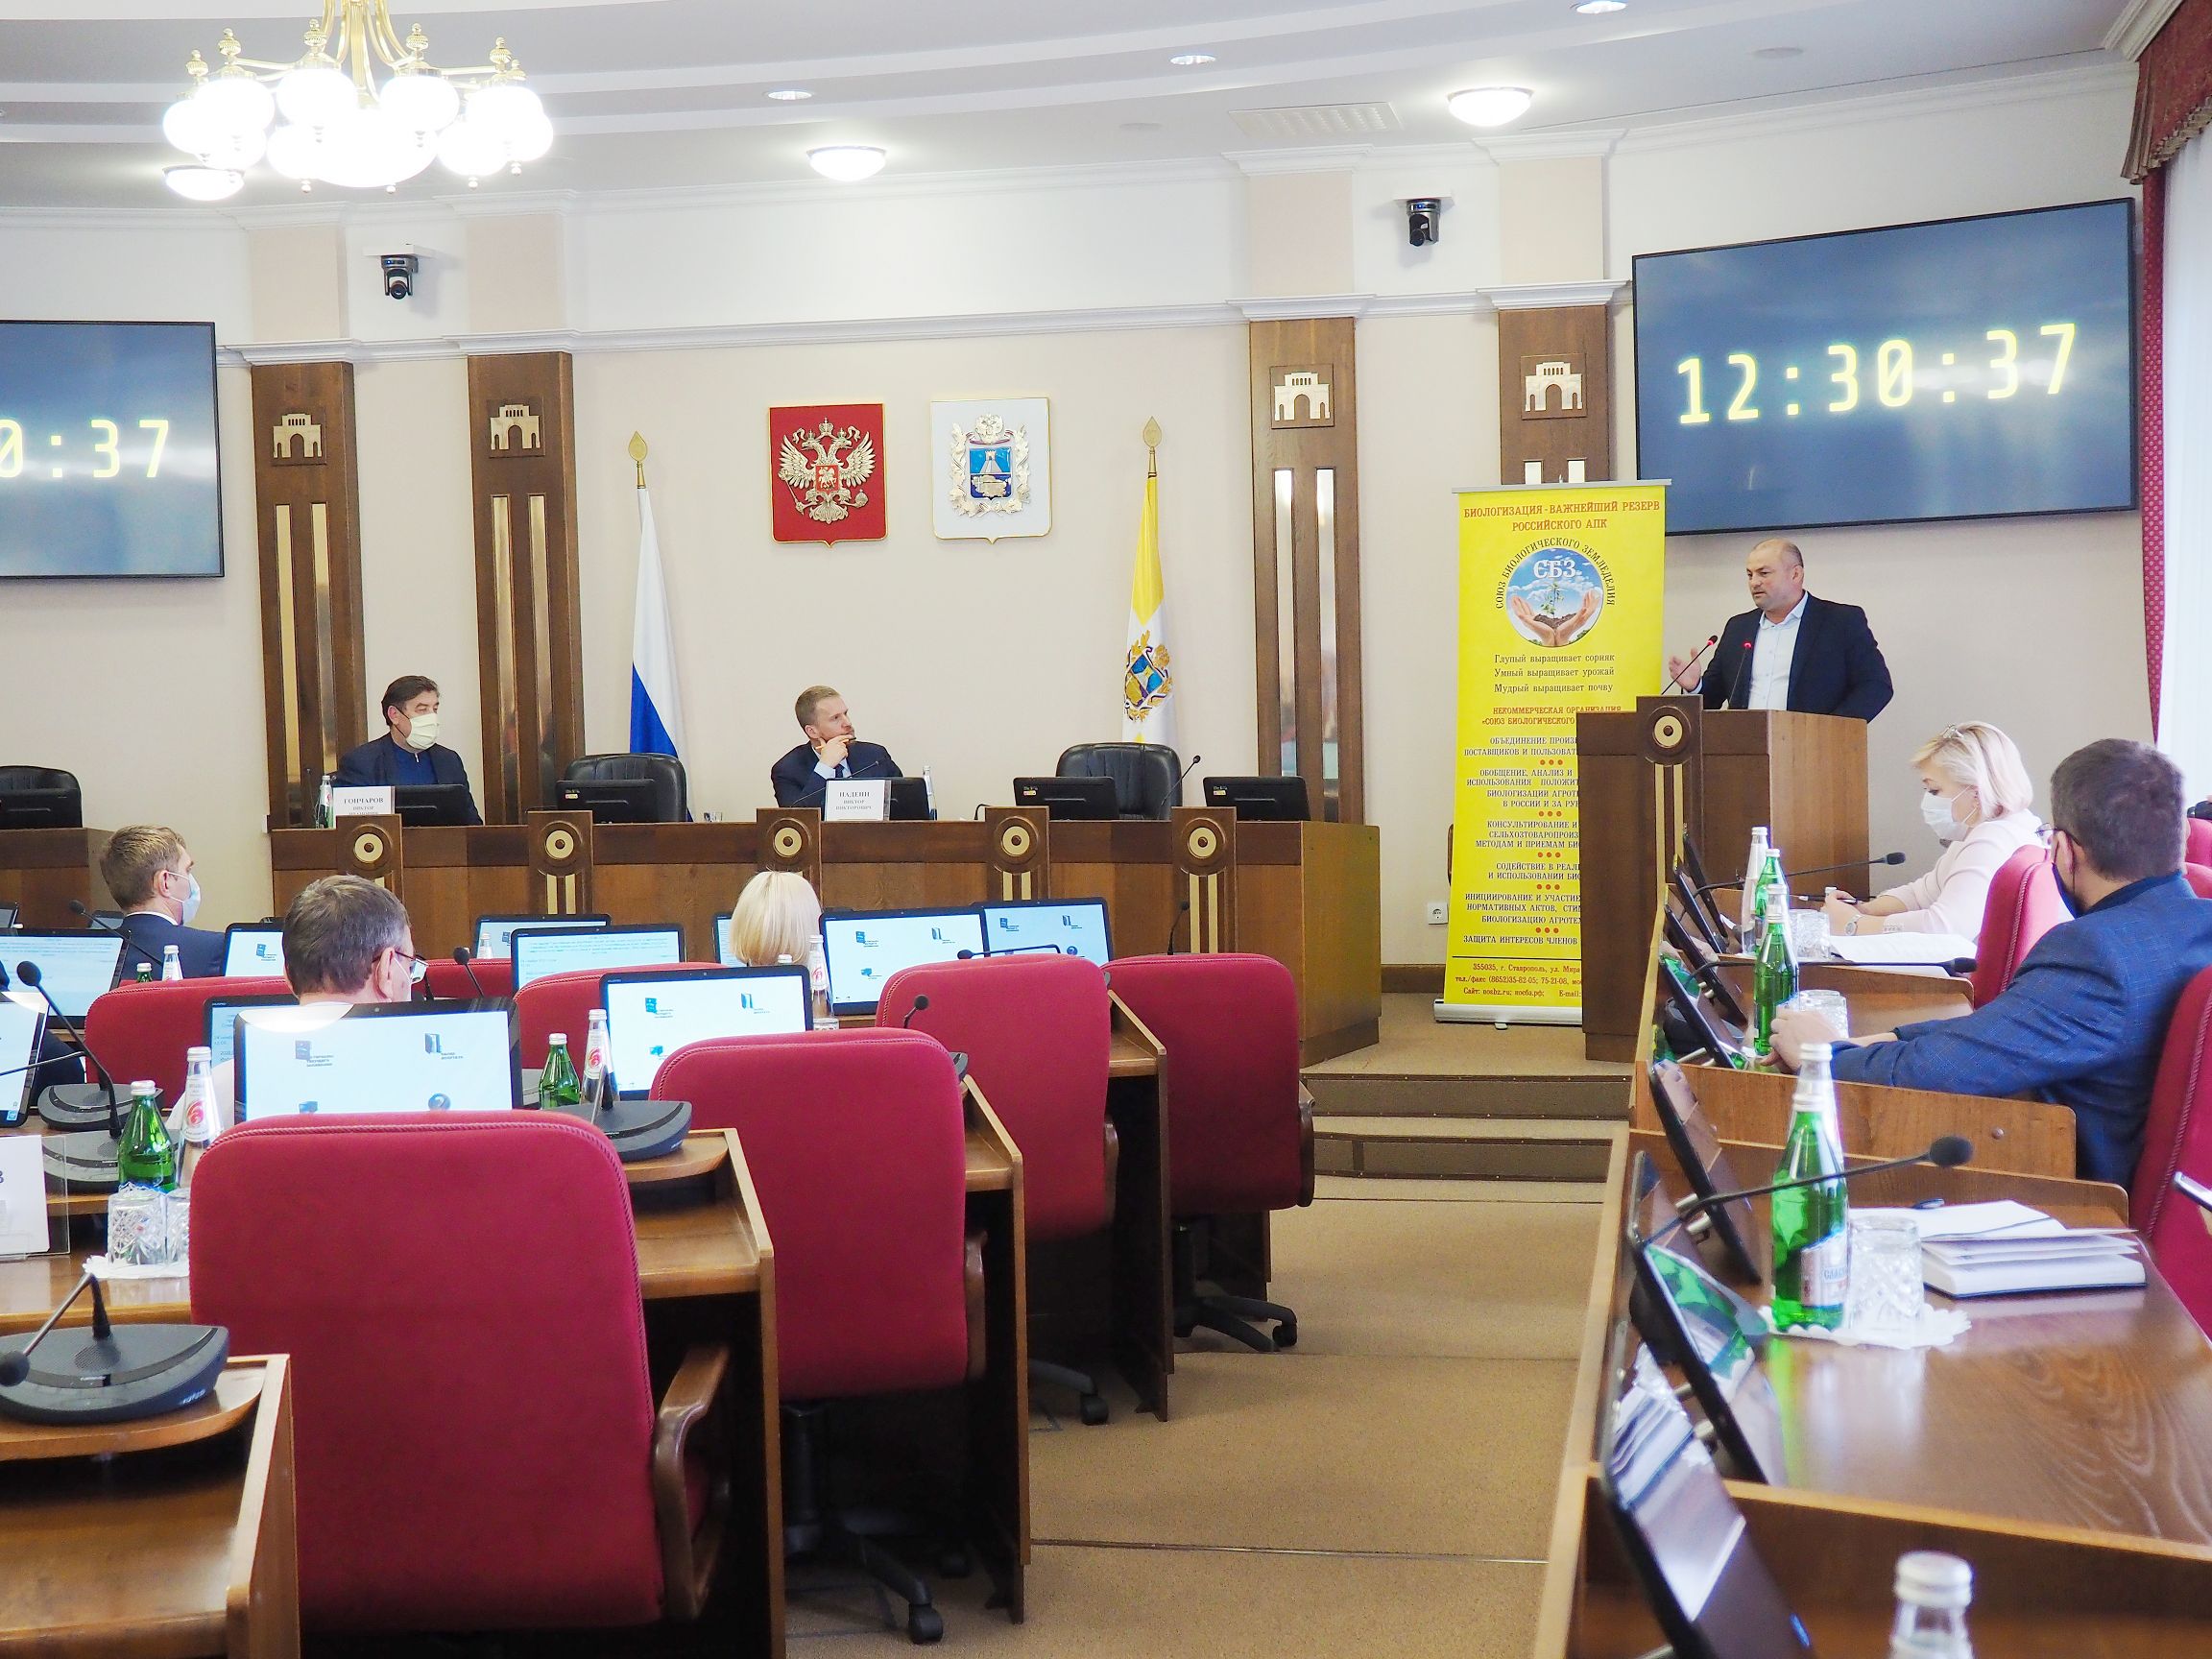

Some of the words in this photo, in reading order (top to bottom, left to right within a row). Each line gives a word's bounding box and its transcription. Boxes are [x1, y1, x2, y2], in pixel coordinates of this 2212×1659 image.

[1677, 324, 2076, 424] 12:30:37
[1464, 505, 1543, 518] БИОЛОГИЗАЦИЯ
[1550, 501, 1619, 514] ВАЖНЕЙШИЙ
[1623, 501, 1660, 511] РЕЗЕРВ
[1512, 519, 1582, 532] РОССИЙСКОГО
[1586, 518, 1607, 528] АПК
[1496, 581, 1506, 609] СОЮЗ
[1502, 538, 1580, 579] БИОЛОГИЧЕСКОГО
[1581, 544, 1616, 605] ЗЕМЛЕДЕЛИЯ
[1533, 559, 1576, 578] СБЗ
[1494, 654, 1527, 664] Глупый
[1530, 655, 1581, 664] выращивает
[1585, 654, 1615, 663] сорняк
[1494, 668, 1523, 677] Умный
[1527, 669, 1578, 678] выращивает
[1582, 667, 1615, 678] урожай
[1494, 684, 1528, 693] Мудрый
[1533, 685, 1584, 693] выращивает
[1588, 684, 1613, 692] почву
[1486, 790, 1549, 799] БИОЛОГИЗАЦИИ
[1496, 862, 1546, 871] СОДЕЙСТВИЕ
[1465, 893, 1533, 902] ИНИЦИИРОВАНИЕ
[1481, 916, 1546, 925] БИОЛОГИЗАЦИЮ
[1463, 935, 1497, 944] ЗАЩИТА
